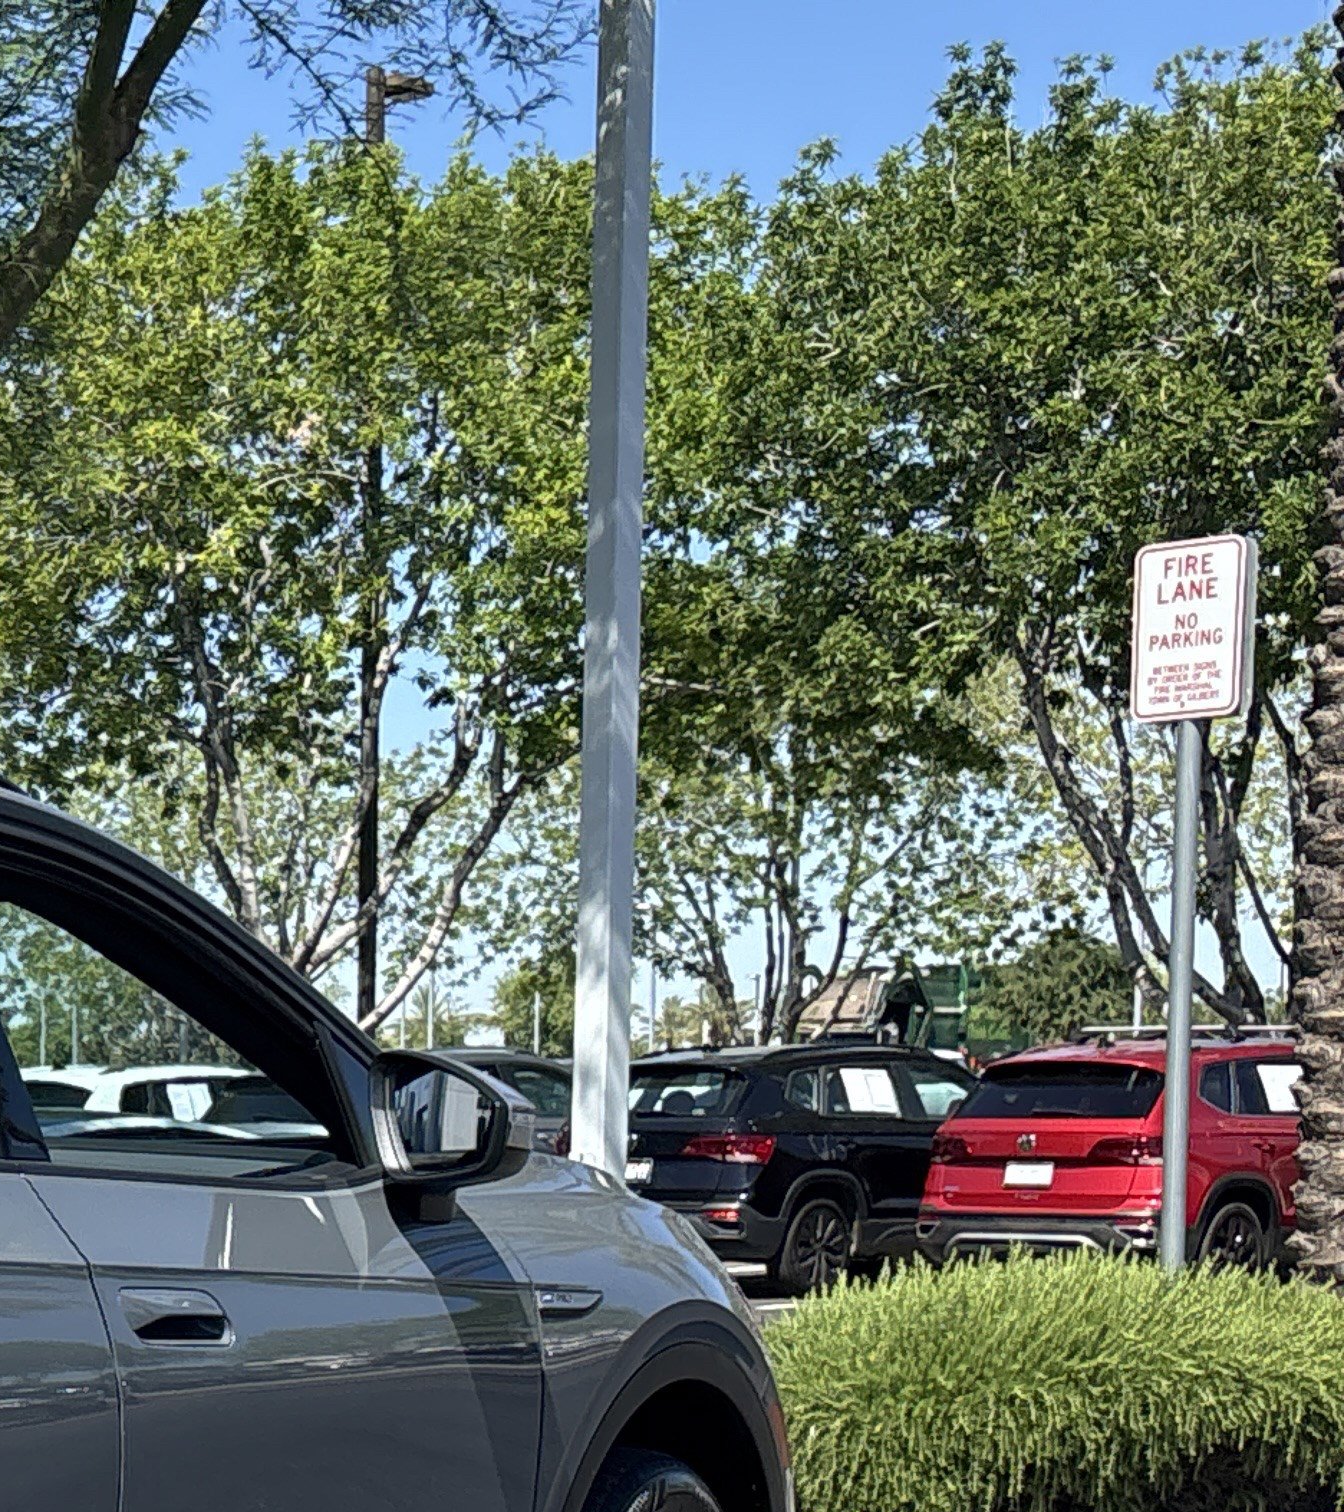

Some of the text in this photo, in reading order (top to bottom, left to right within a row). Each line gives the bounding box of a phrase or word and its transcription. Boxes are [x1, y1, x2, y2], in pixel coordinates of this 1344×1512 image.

[1164, 552, 1213, 579] FIRE
[1157, 577, 1218, 605] LANE
[1175, 612, 1198, 630] NO
[1148, 627, 1223, 652] PARKING
